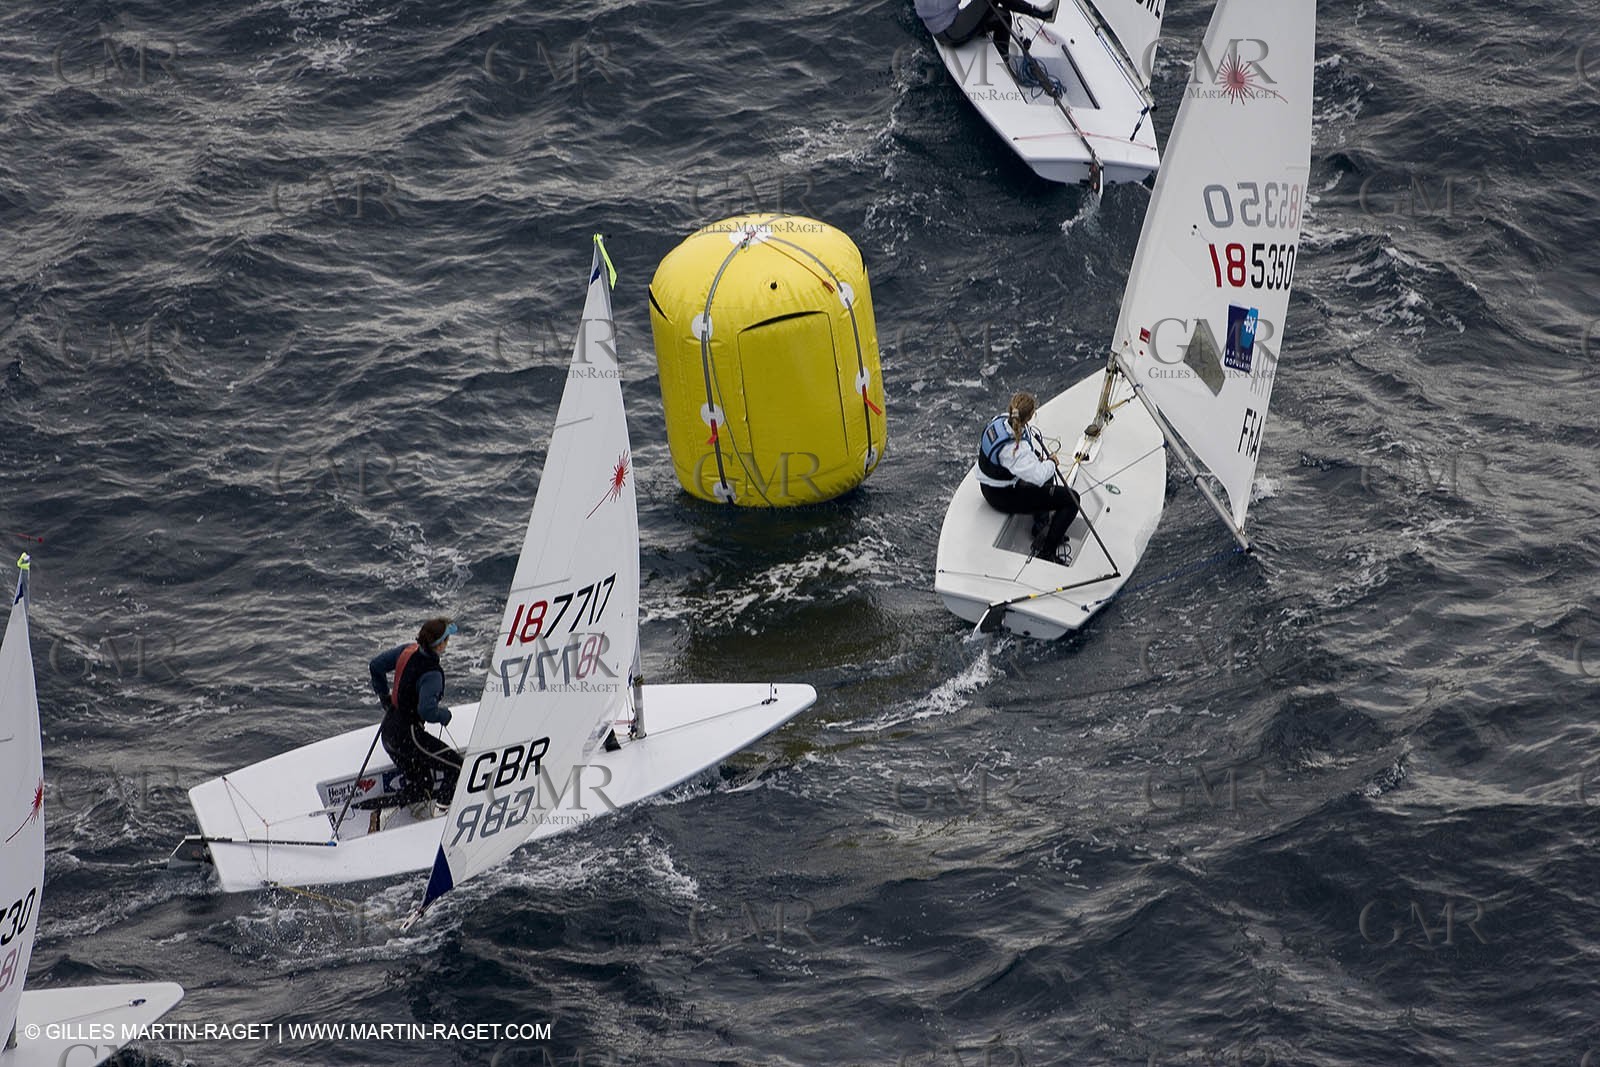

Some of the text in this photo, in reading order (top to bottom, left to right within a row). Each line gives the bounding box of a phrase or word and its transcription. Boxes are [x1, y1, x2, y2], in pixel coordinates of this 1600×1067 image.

[1208, 243, 1295, 290] 185350
[506, 573, 617, 646] 187717
[467, 736, 551, 794] GBR
